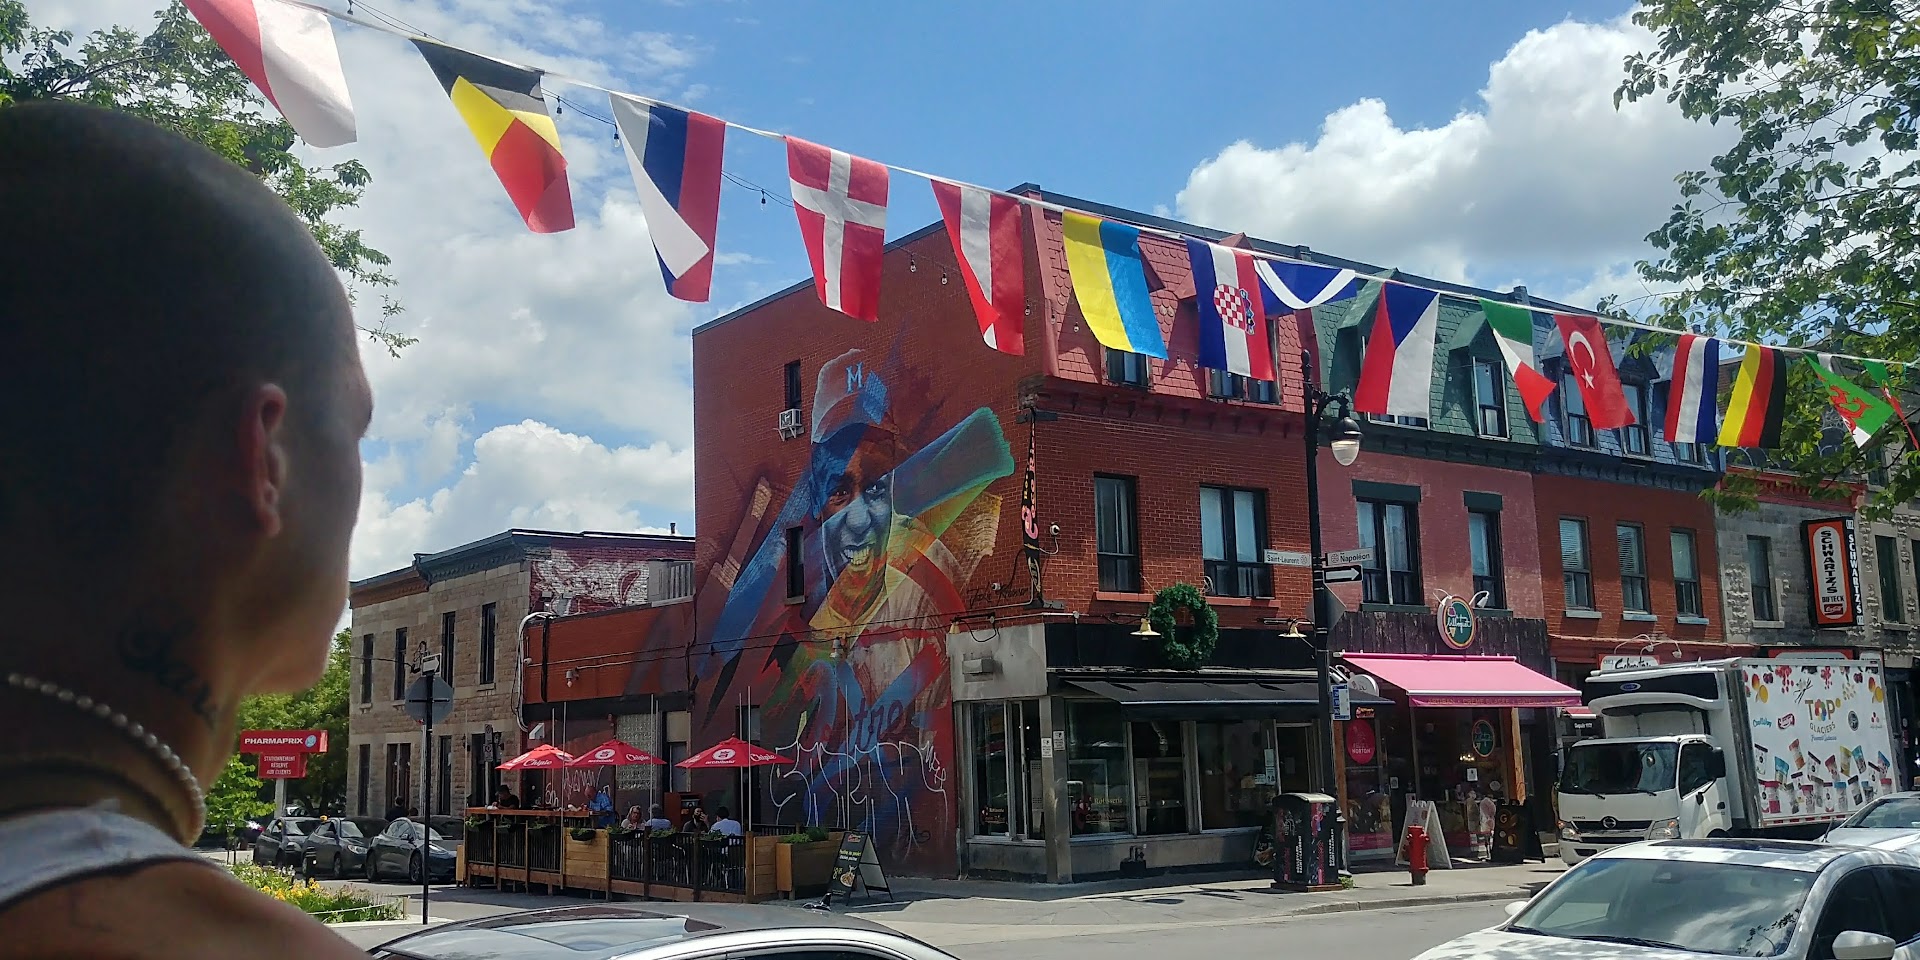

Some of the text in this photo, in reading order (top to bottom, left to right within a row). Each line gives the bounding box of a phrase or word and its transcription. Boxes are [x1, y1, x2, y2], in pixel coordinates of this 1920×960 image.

[846, 362, 863, 393] M
[1821, 531, 1838, 593] SCHWARTZ'S
[1848, 534, 1862, 613] SCHWARTZ'S
[1810, 722, 1836, 734] GLACIERS
